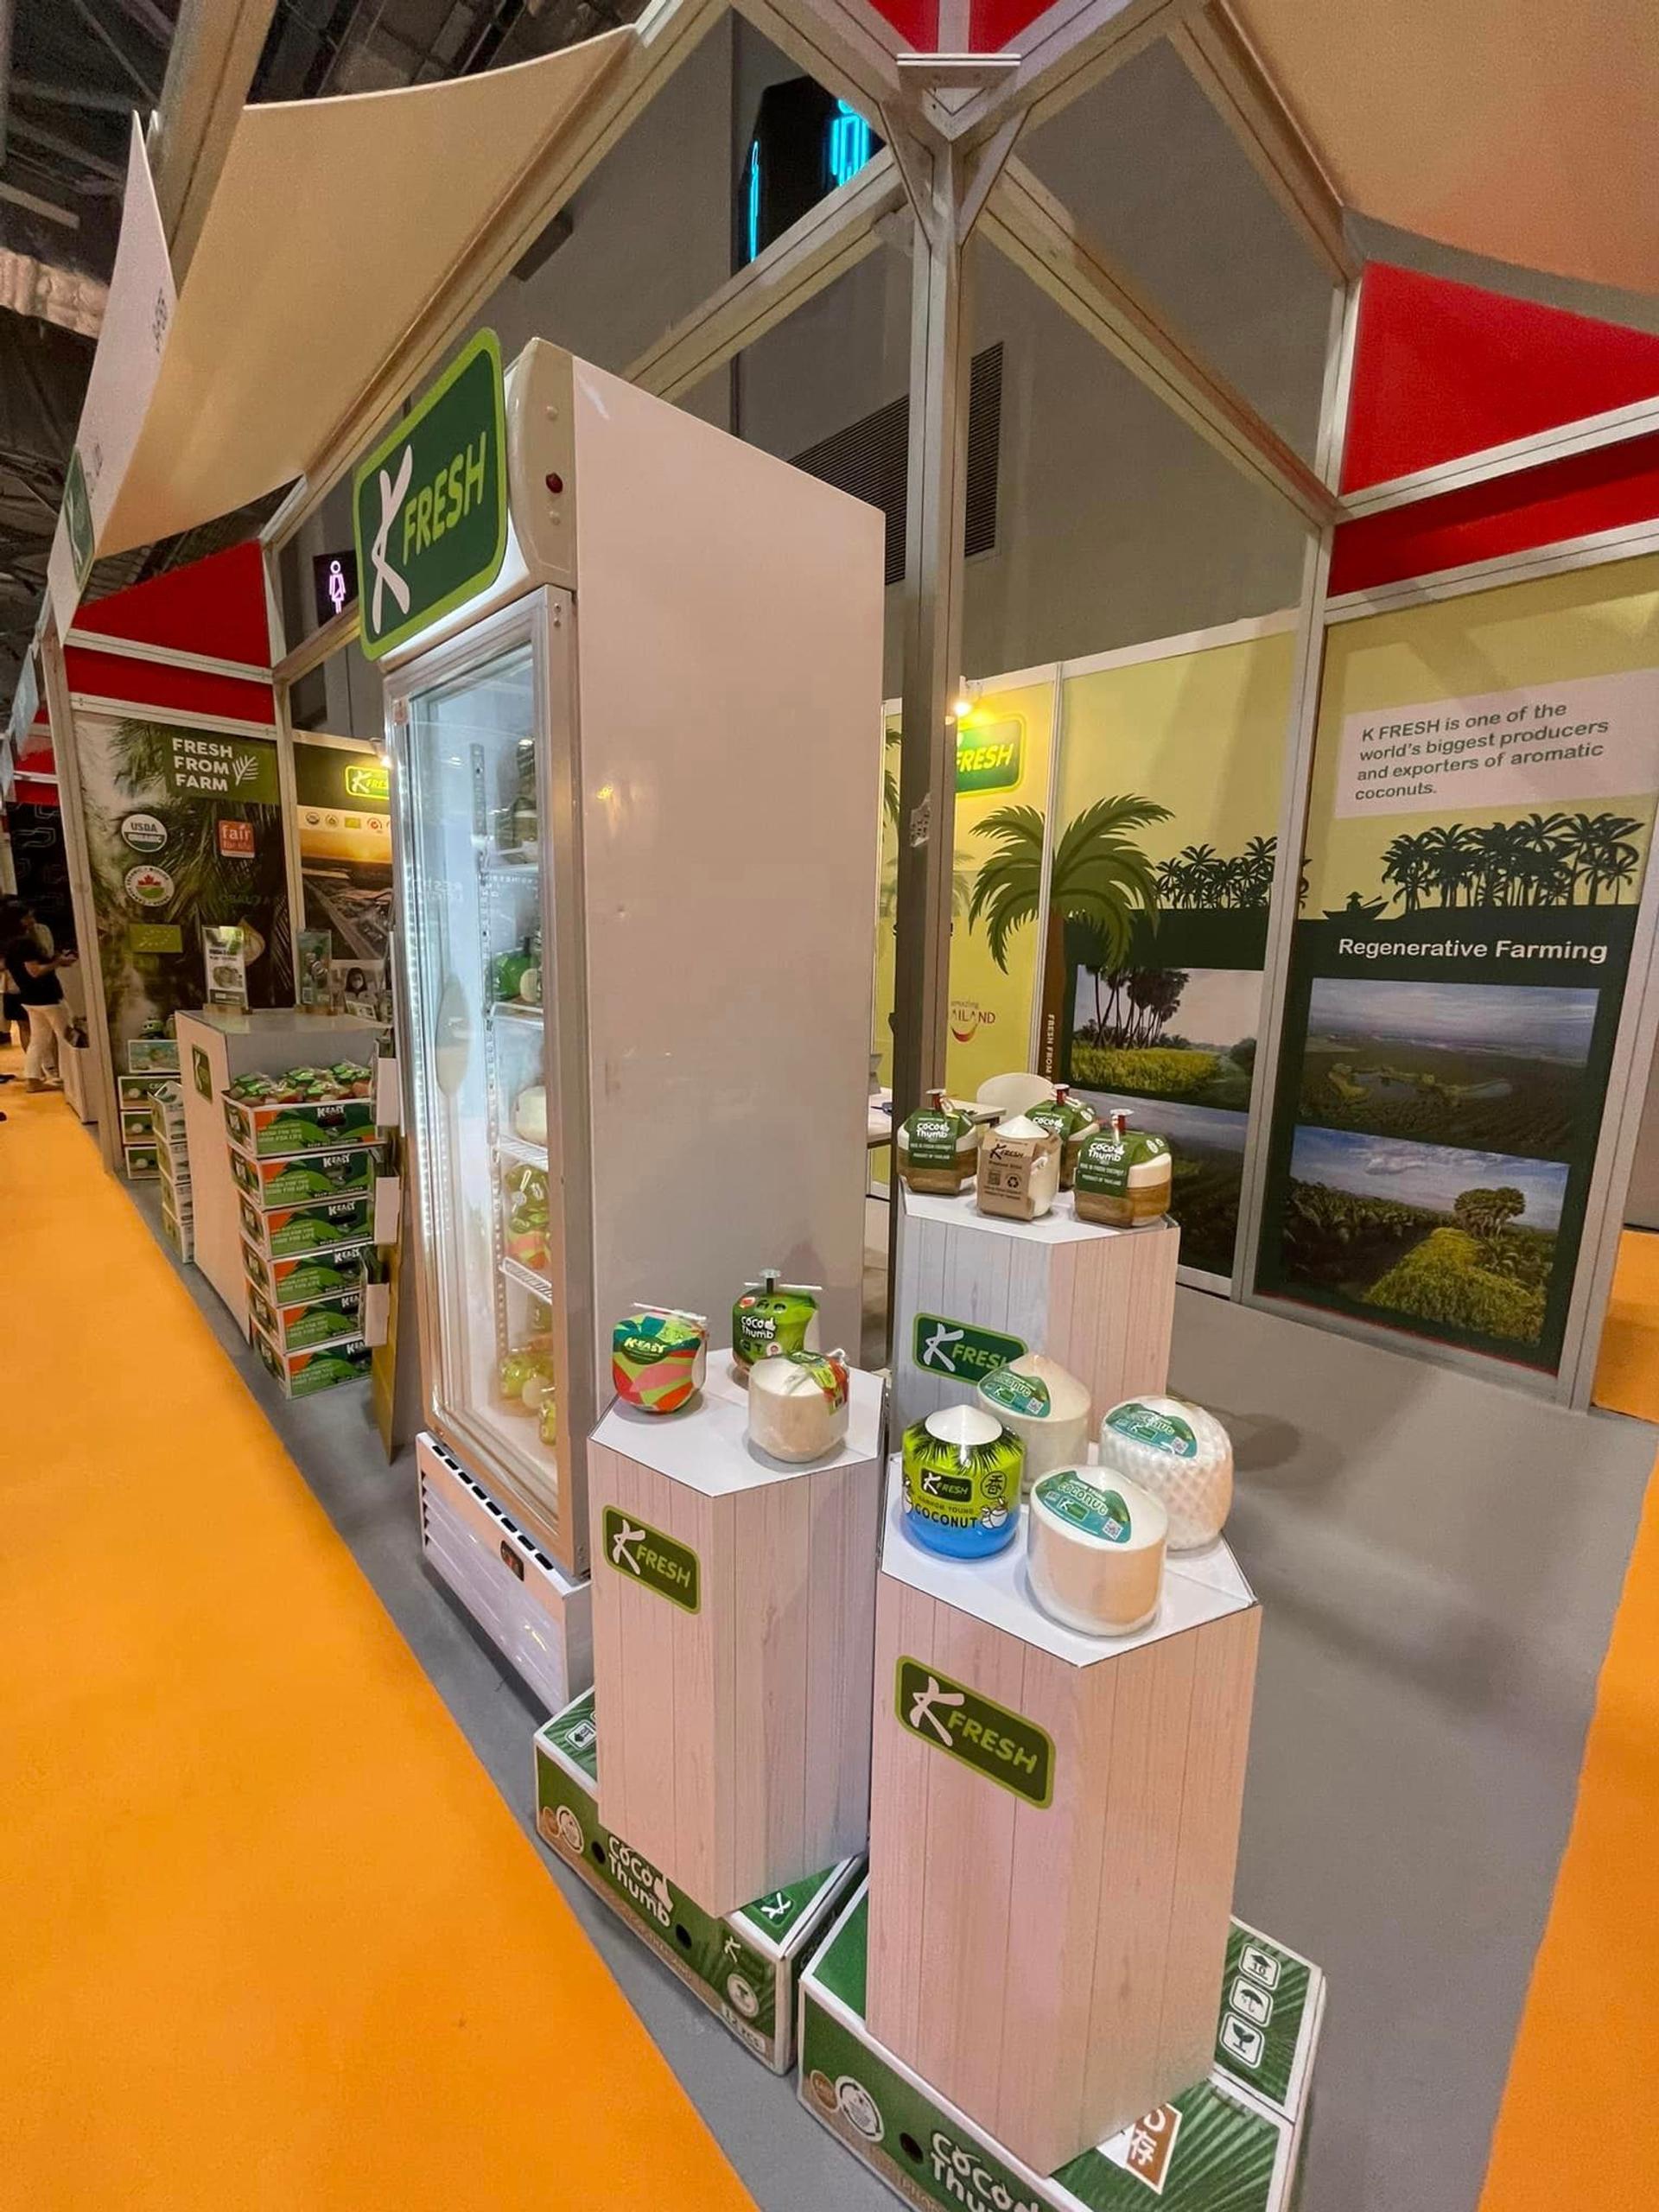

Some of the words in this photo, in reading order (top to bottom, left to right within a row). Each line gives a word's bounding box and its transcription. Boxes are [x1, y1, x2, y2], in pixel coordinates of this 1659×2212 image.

[372, 444, 412, 634] K
[403, 432, 486, 567] FRESH
[1362, 729, 1374, 742] K
[1379, 719, 1440, 740] FRESH
[1445, 717, 1459, 730] is
[1465, 713, 1501, 728] one
[1506, 706, 1529, 722] of
[1535, 703, 1567, 720] the
[173, 737, 233, 759] FRESH
[1359, 742, 1421, 761] world's
[1426, 734, 1495, 757] biggest
[1500, 720, 1609, 748] producers
[174, 755, 230, 775] FROM
[1357, 766, 1388, 781] and
[1392, 759, 1479, 779] exporters
[1484, 752, 1506, 768] of
[1510, 742, 1604, 766] aromatic
[175, 772, 228, 791] FARM
[352, 770, 372, 793] K
[366, 779, 387, 788] FRE
[1355, 781, 1438, 800] coconuts.
[130, 823, 157, 832] USDA
[223, 823, 251, 841] fair
[1338, 938, 1488, 959] Regenerative
[1495, 939, 1608, 963] Farming
[952, 1009, 996, 1024] AILAND
[923, 1323, 965, 1372] K
[924, 1472, 941, 1495] K
[936, 1481, 968, 1495] FRESH
[915, 1503, 978, 1529] COCONUT
[612, 1519, 645, 1575] K
[636, 1544, 691, 1588] FRESH
[910, 1676, 965, 1747] K
[948, 1711, 1038, 1774] FRESH
[608, 1853, 671, 1927] Thumb
[931, 2152, 985, 2212] Thu
